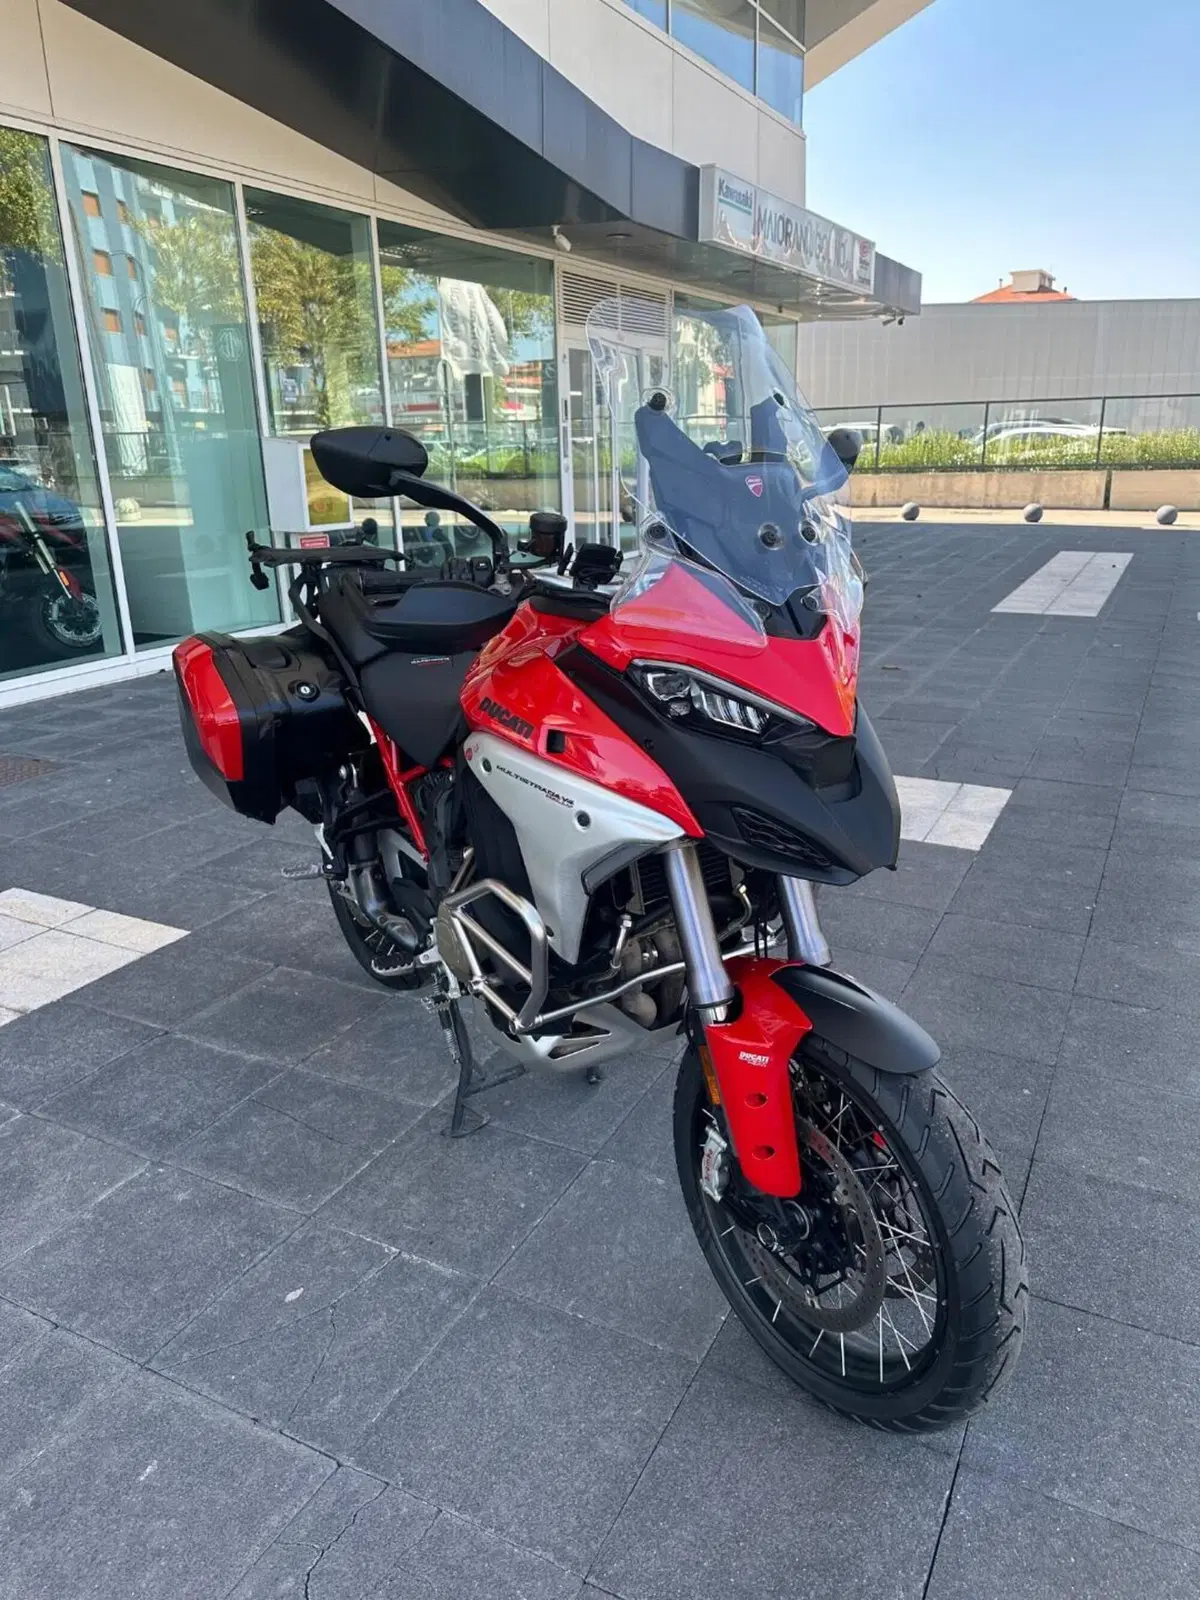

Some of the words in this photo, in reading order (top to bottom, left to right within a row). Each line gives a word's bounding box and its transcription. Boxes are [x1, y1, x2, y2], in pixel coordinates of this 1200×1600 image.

[480, 697, 534, 740] DUCATI
[496, 765, 561, 799] MULTISTRADA
[739, 1051, 769, 1065] DUCATI
